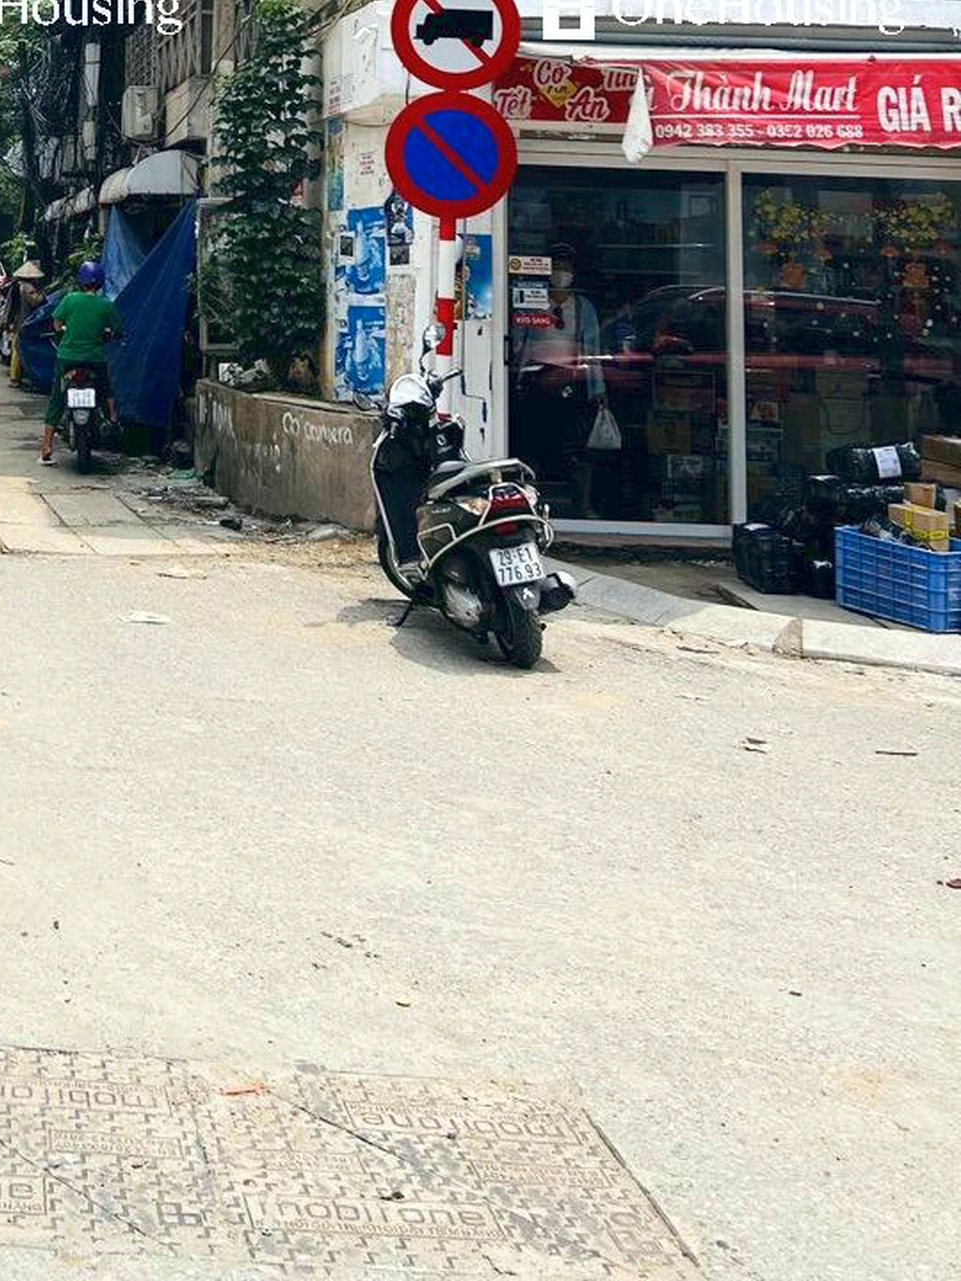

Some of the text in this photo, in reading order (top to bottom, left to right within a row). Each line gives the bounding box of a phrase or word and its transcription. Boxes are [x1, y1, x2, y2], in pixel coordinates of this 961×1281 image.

[565, 87, 609, 120] An
[668, 70, 774, 112] Thành
[779, 70, 860, 112] Mart
[877, 74, 931, 132] GIÁ
[941, 86, 961, 132] R
[655, 124, 692, 138] 0942
[258, 1199, 486, 1226] mobifone
